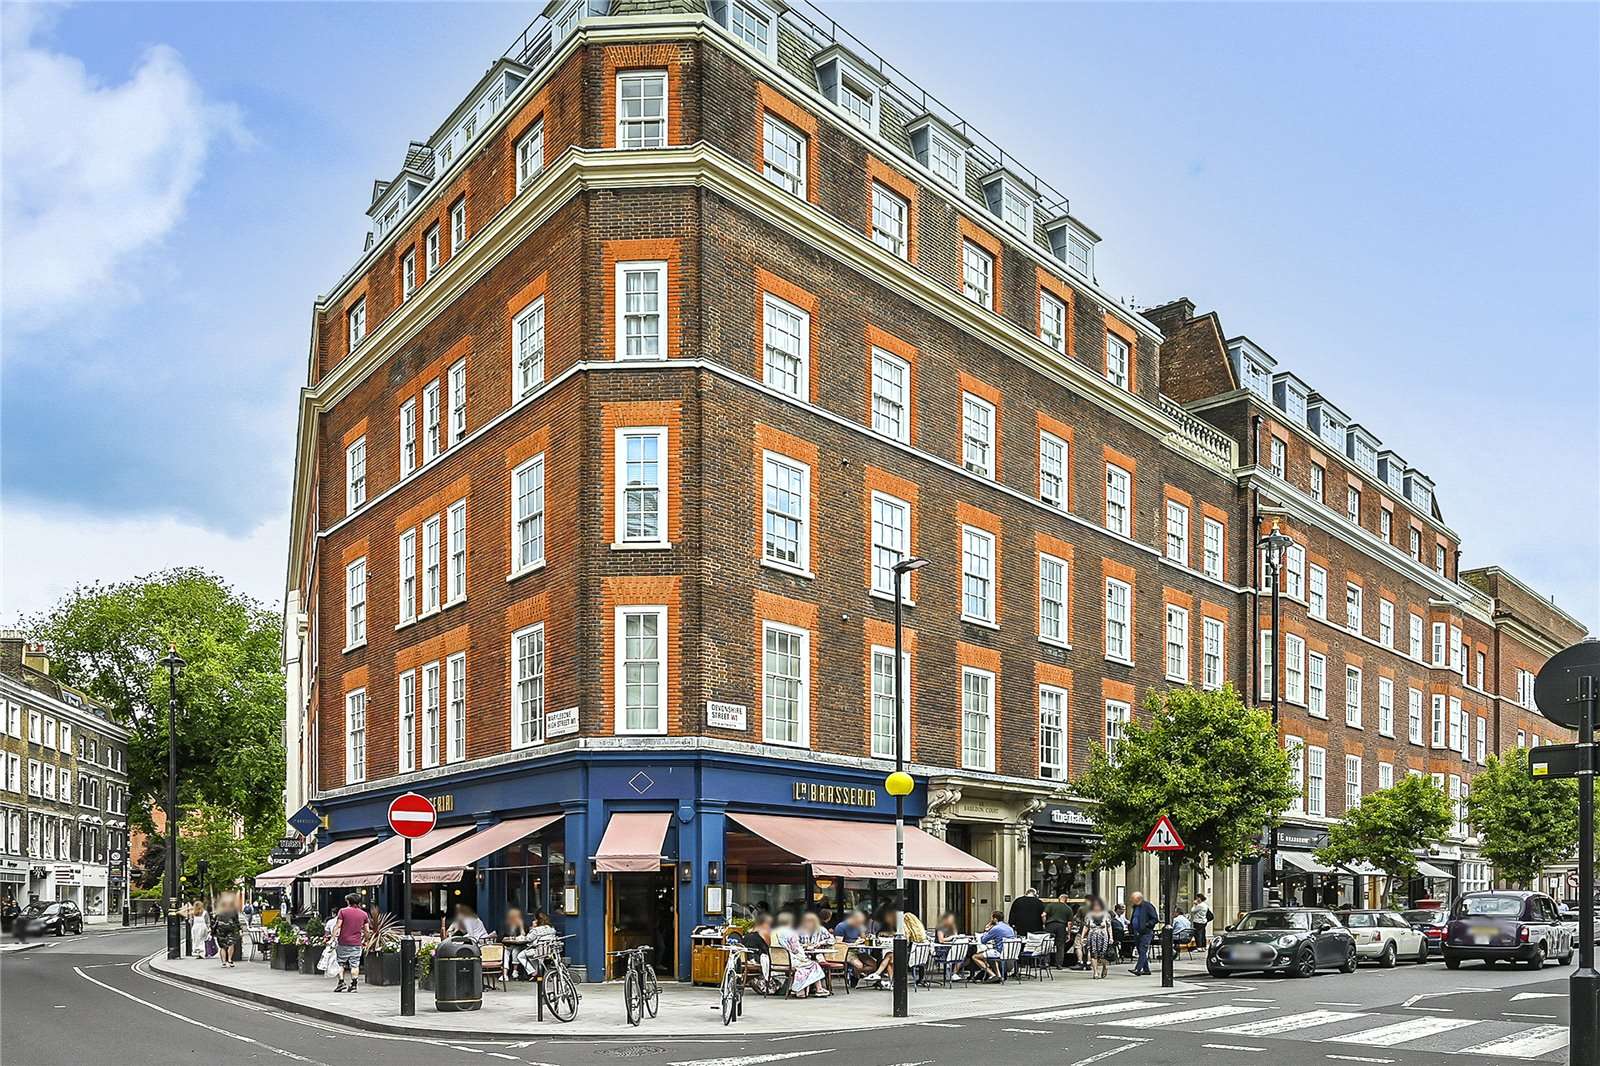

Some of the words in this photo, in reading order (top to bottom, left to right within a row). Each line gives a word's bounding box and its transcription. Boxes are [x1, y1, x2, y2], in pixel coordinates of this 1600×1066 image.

[711, 703, 743, 715] DEVONSHIRE
[547, 710, 572, 721] MARYLEBONE
[711, 711, 730, 720] STREET
[731, 713, 738, 721] W1
[547, 721, 556, 730] HIGH
[557, 718, 570, 728] STREET
[810, 783, 877, 807] BRASSERIA
